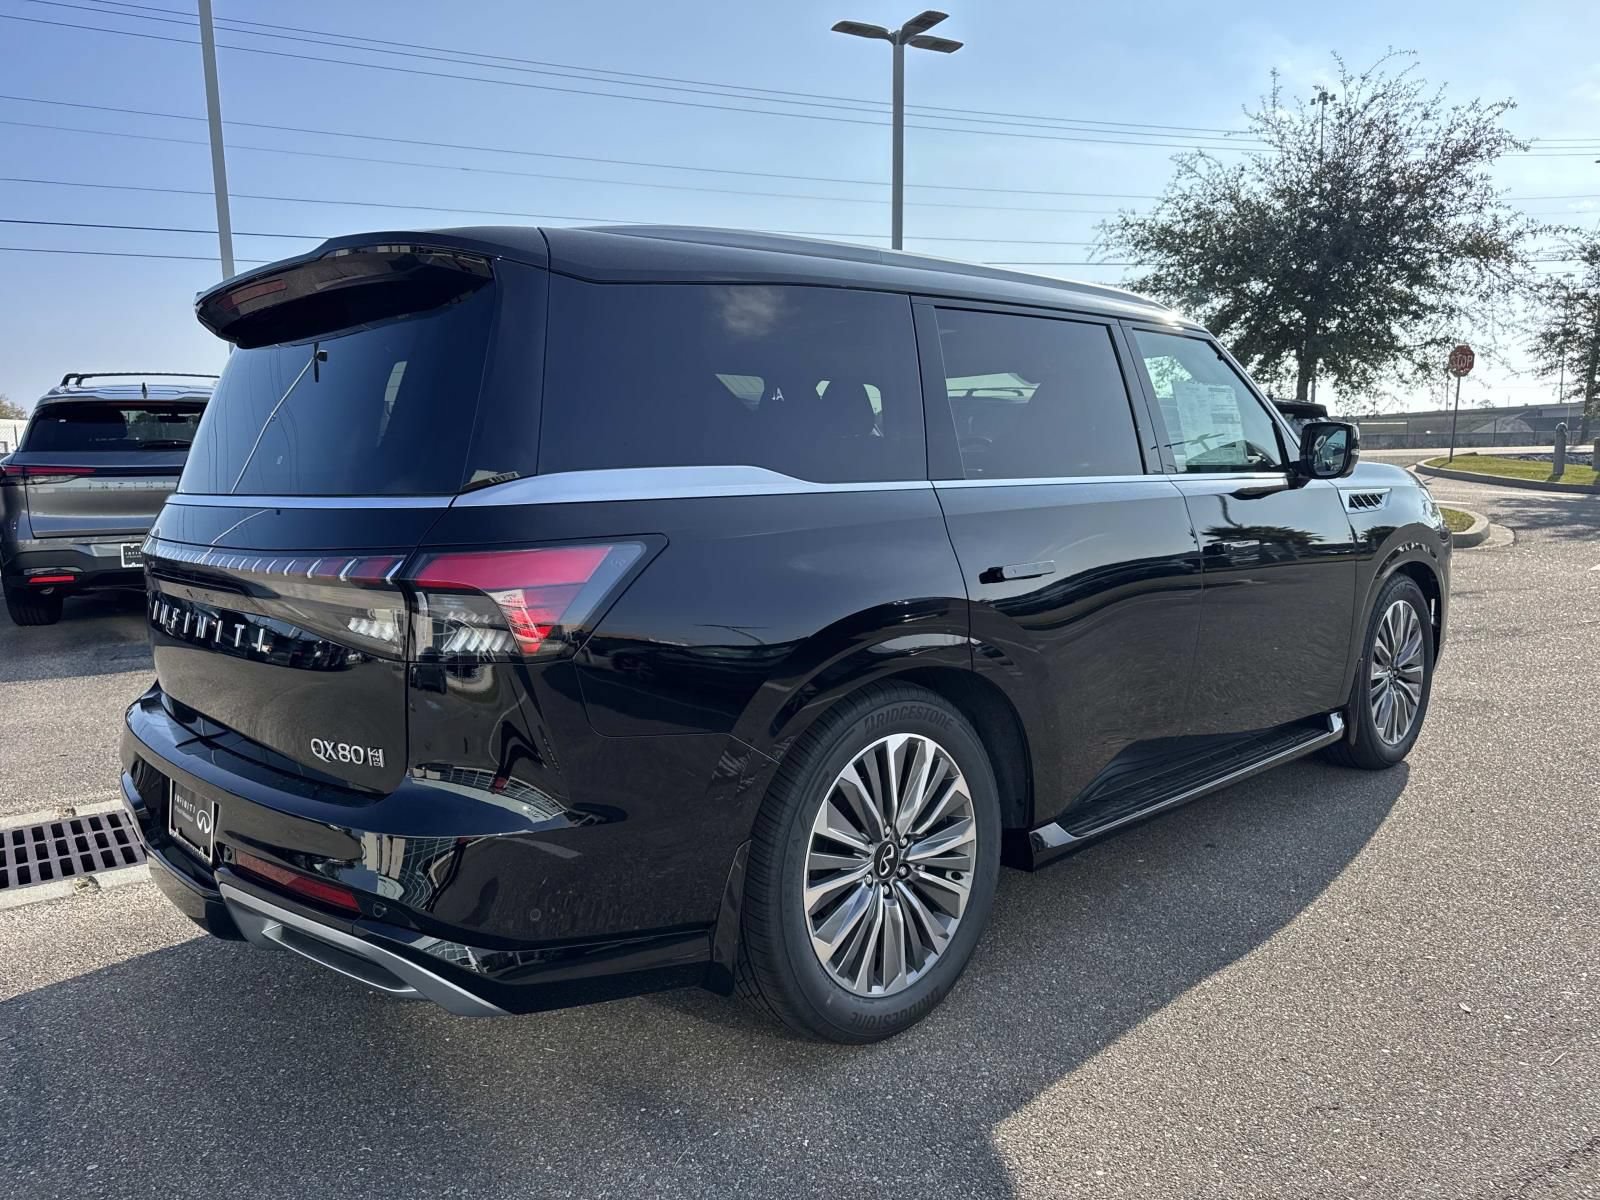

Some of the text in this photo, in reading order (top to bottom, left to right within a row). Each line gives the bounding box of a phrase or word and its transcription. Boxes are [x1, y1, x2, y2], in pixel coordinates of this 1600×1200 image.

[1450, 354, 1473, 369] STOP
[152, 600, 266, 652] INFINITI
[864, 705, 954, 733] BRIDGESTONE
[310, 738, 364, 765] QX80
